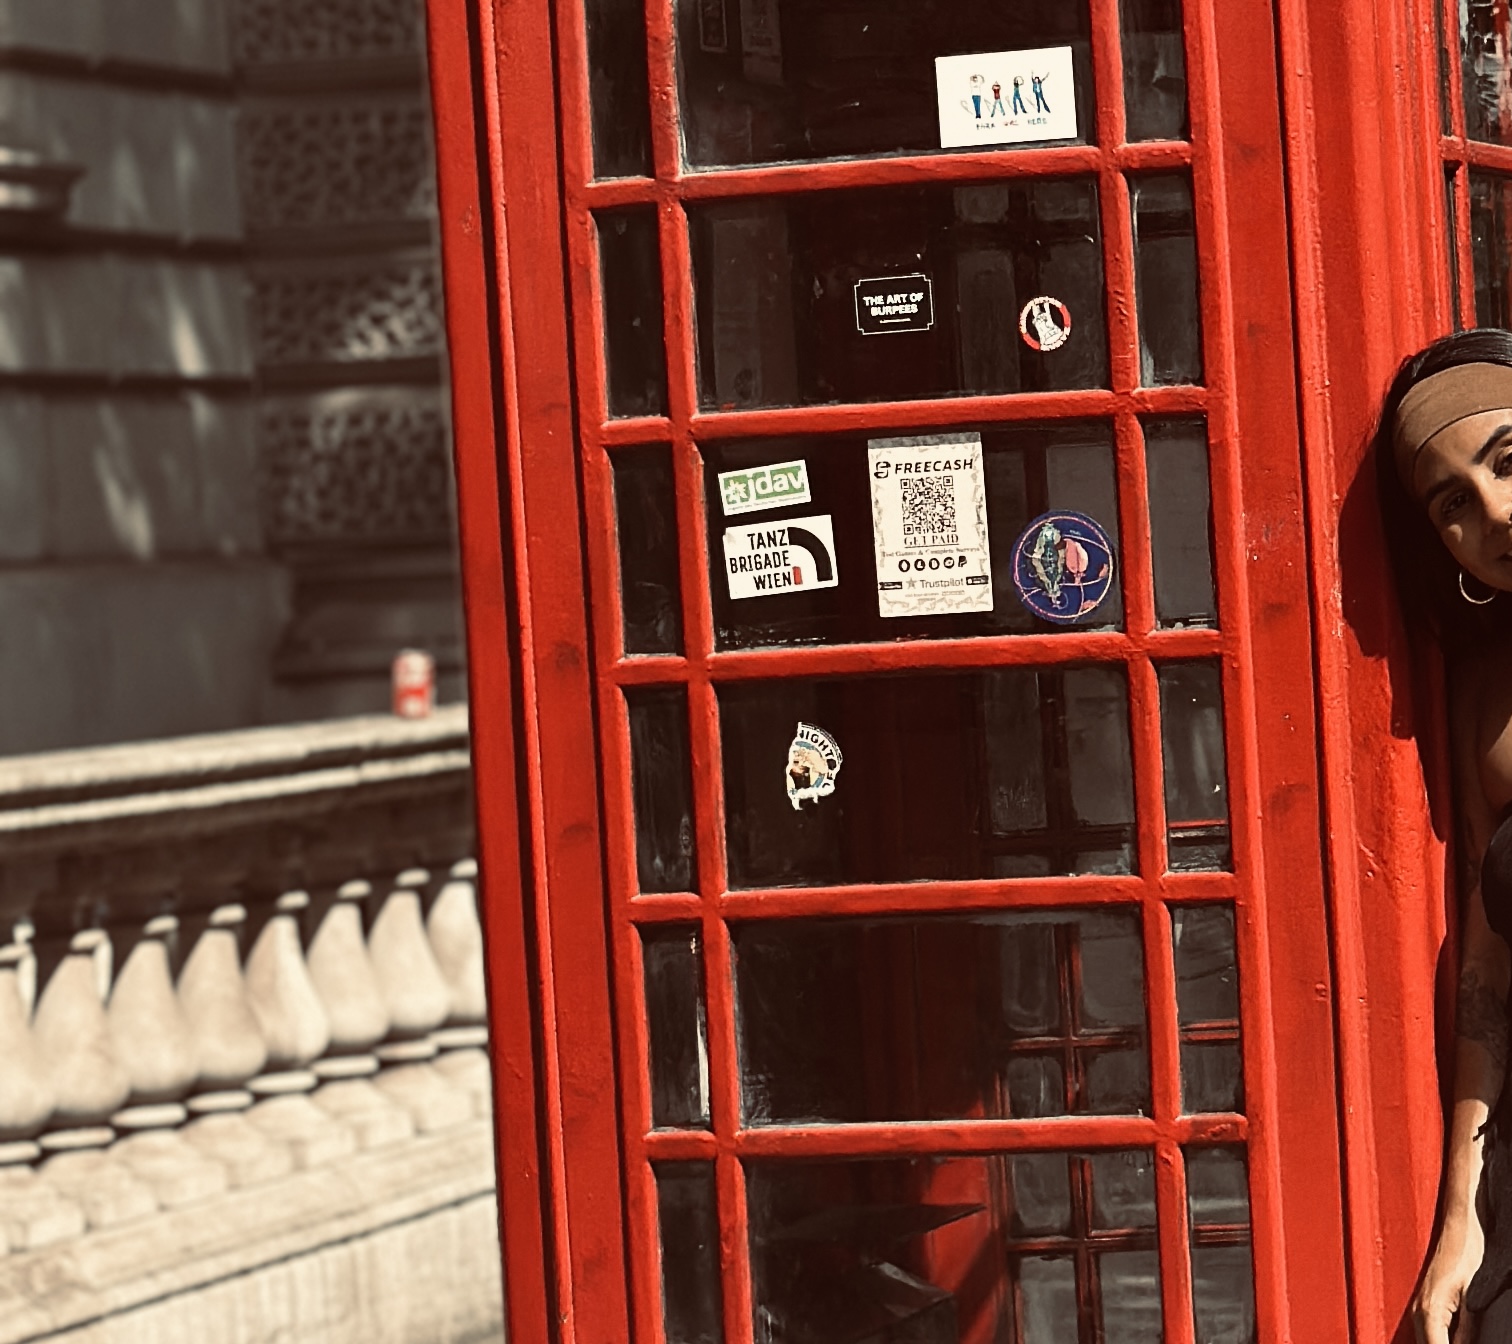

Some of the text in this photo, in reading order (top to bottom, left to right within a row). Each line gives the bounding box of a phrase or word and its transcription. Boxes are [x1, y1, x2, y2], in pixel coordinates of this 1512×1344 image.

[862, 292, 924, 306] THE ART OF
[870, 303, 919, 317] BURPEES
[894, 458, 974, 475] FREECASH
[746, 470, 804, 502] jdav
[746, 528, 788, 550] TANZ
[903, 534, 959, 546] GET PAID
[729, 550, 792, 573] BRIGADE
[753, 571, 792, 590] WIEN
[919, 578, 964, 589] Trustpilot
